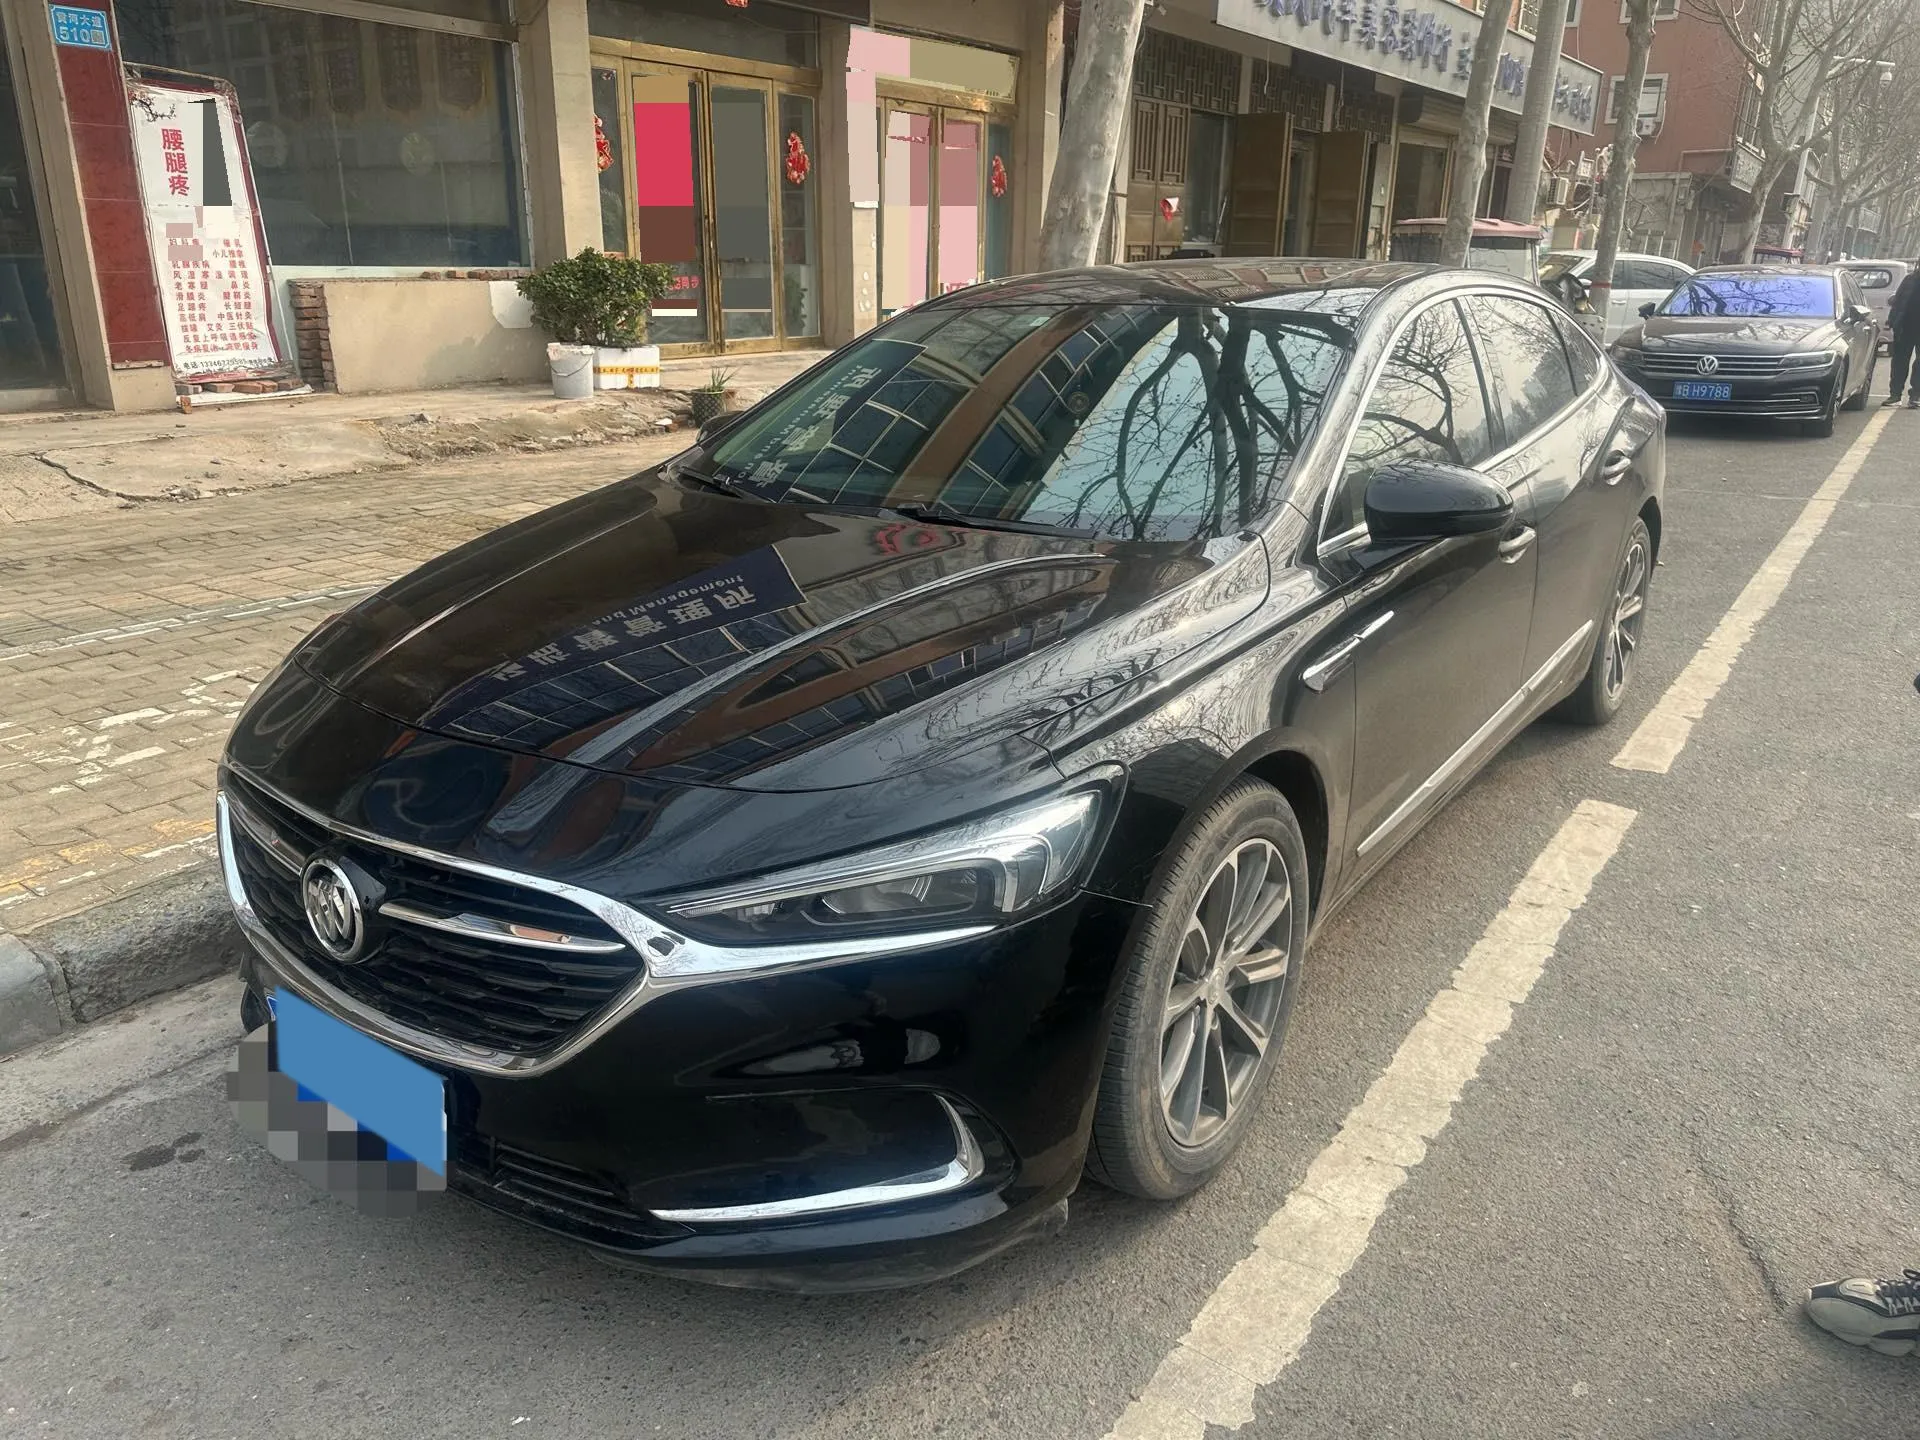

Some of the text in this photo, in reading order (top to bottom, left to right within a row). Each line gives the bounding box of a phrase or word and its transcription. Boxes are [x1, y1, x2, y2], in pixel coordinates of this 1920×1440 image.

[56, 12, 103, 28] 黄河大道
[60, 26, 91, 43] 510
[161, 128, 190, 196] 腰腿疼
[217, 311, 253, 321] 中医针灸
